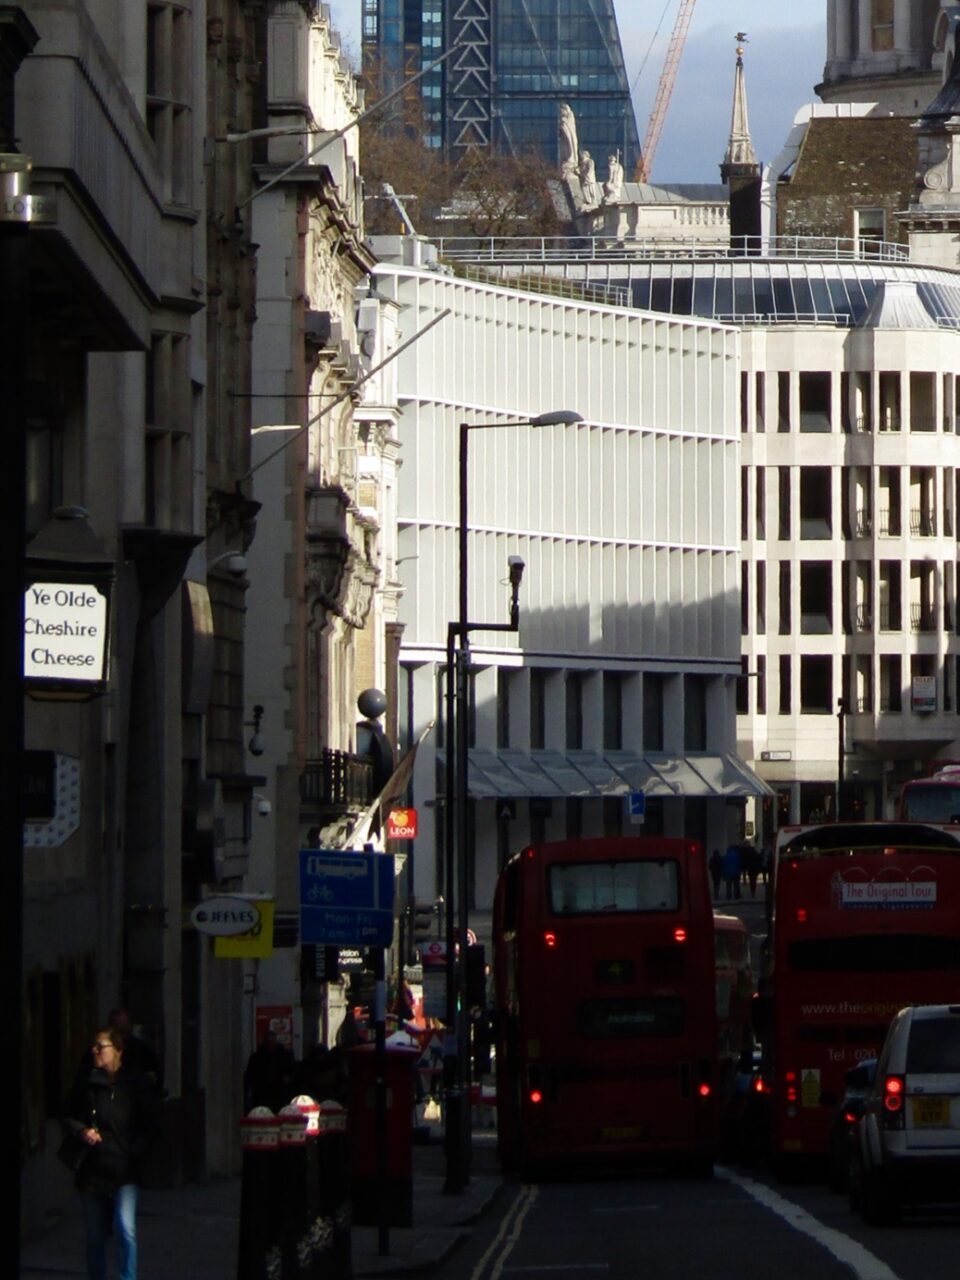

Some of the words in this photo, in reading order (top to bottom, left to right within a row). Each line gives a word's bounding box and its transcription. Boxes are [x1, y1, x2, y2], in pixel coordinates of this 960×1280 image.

[32, 588, 51, 605] Ye
[55, 590, 97, 608] Olde
[24, 617, 97, 637] Cheshire
[31, 648, 95, 666] Cheese
[390, 826, 415, 836] LEON
[847, 884, 863, 897] The
[867, 883, 908, 901] Original
[911, 884, 932, 897] Tour
[211, 910, 254, 923] JEEVES
[827, 1049, 845, 1061] Tel
[854, 1049, 877, 1061] 020
